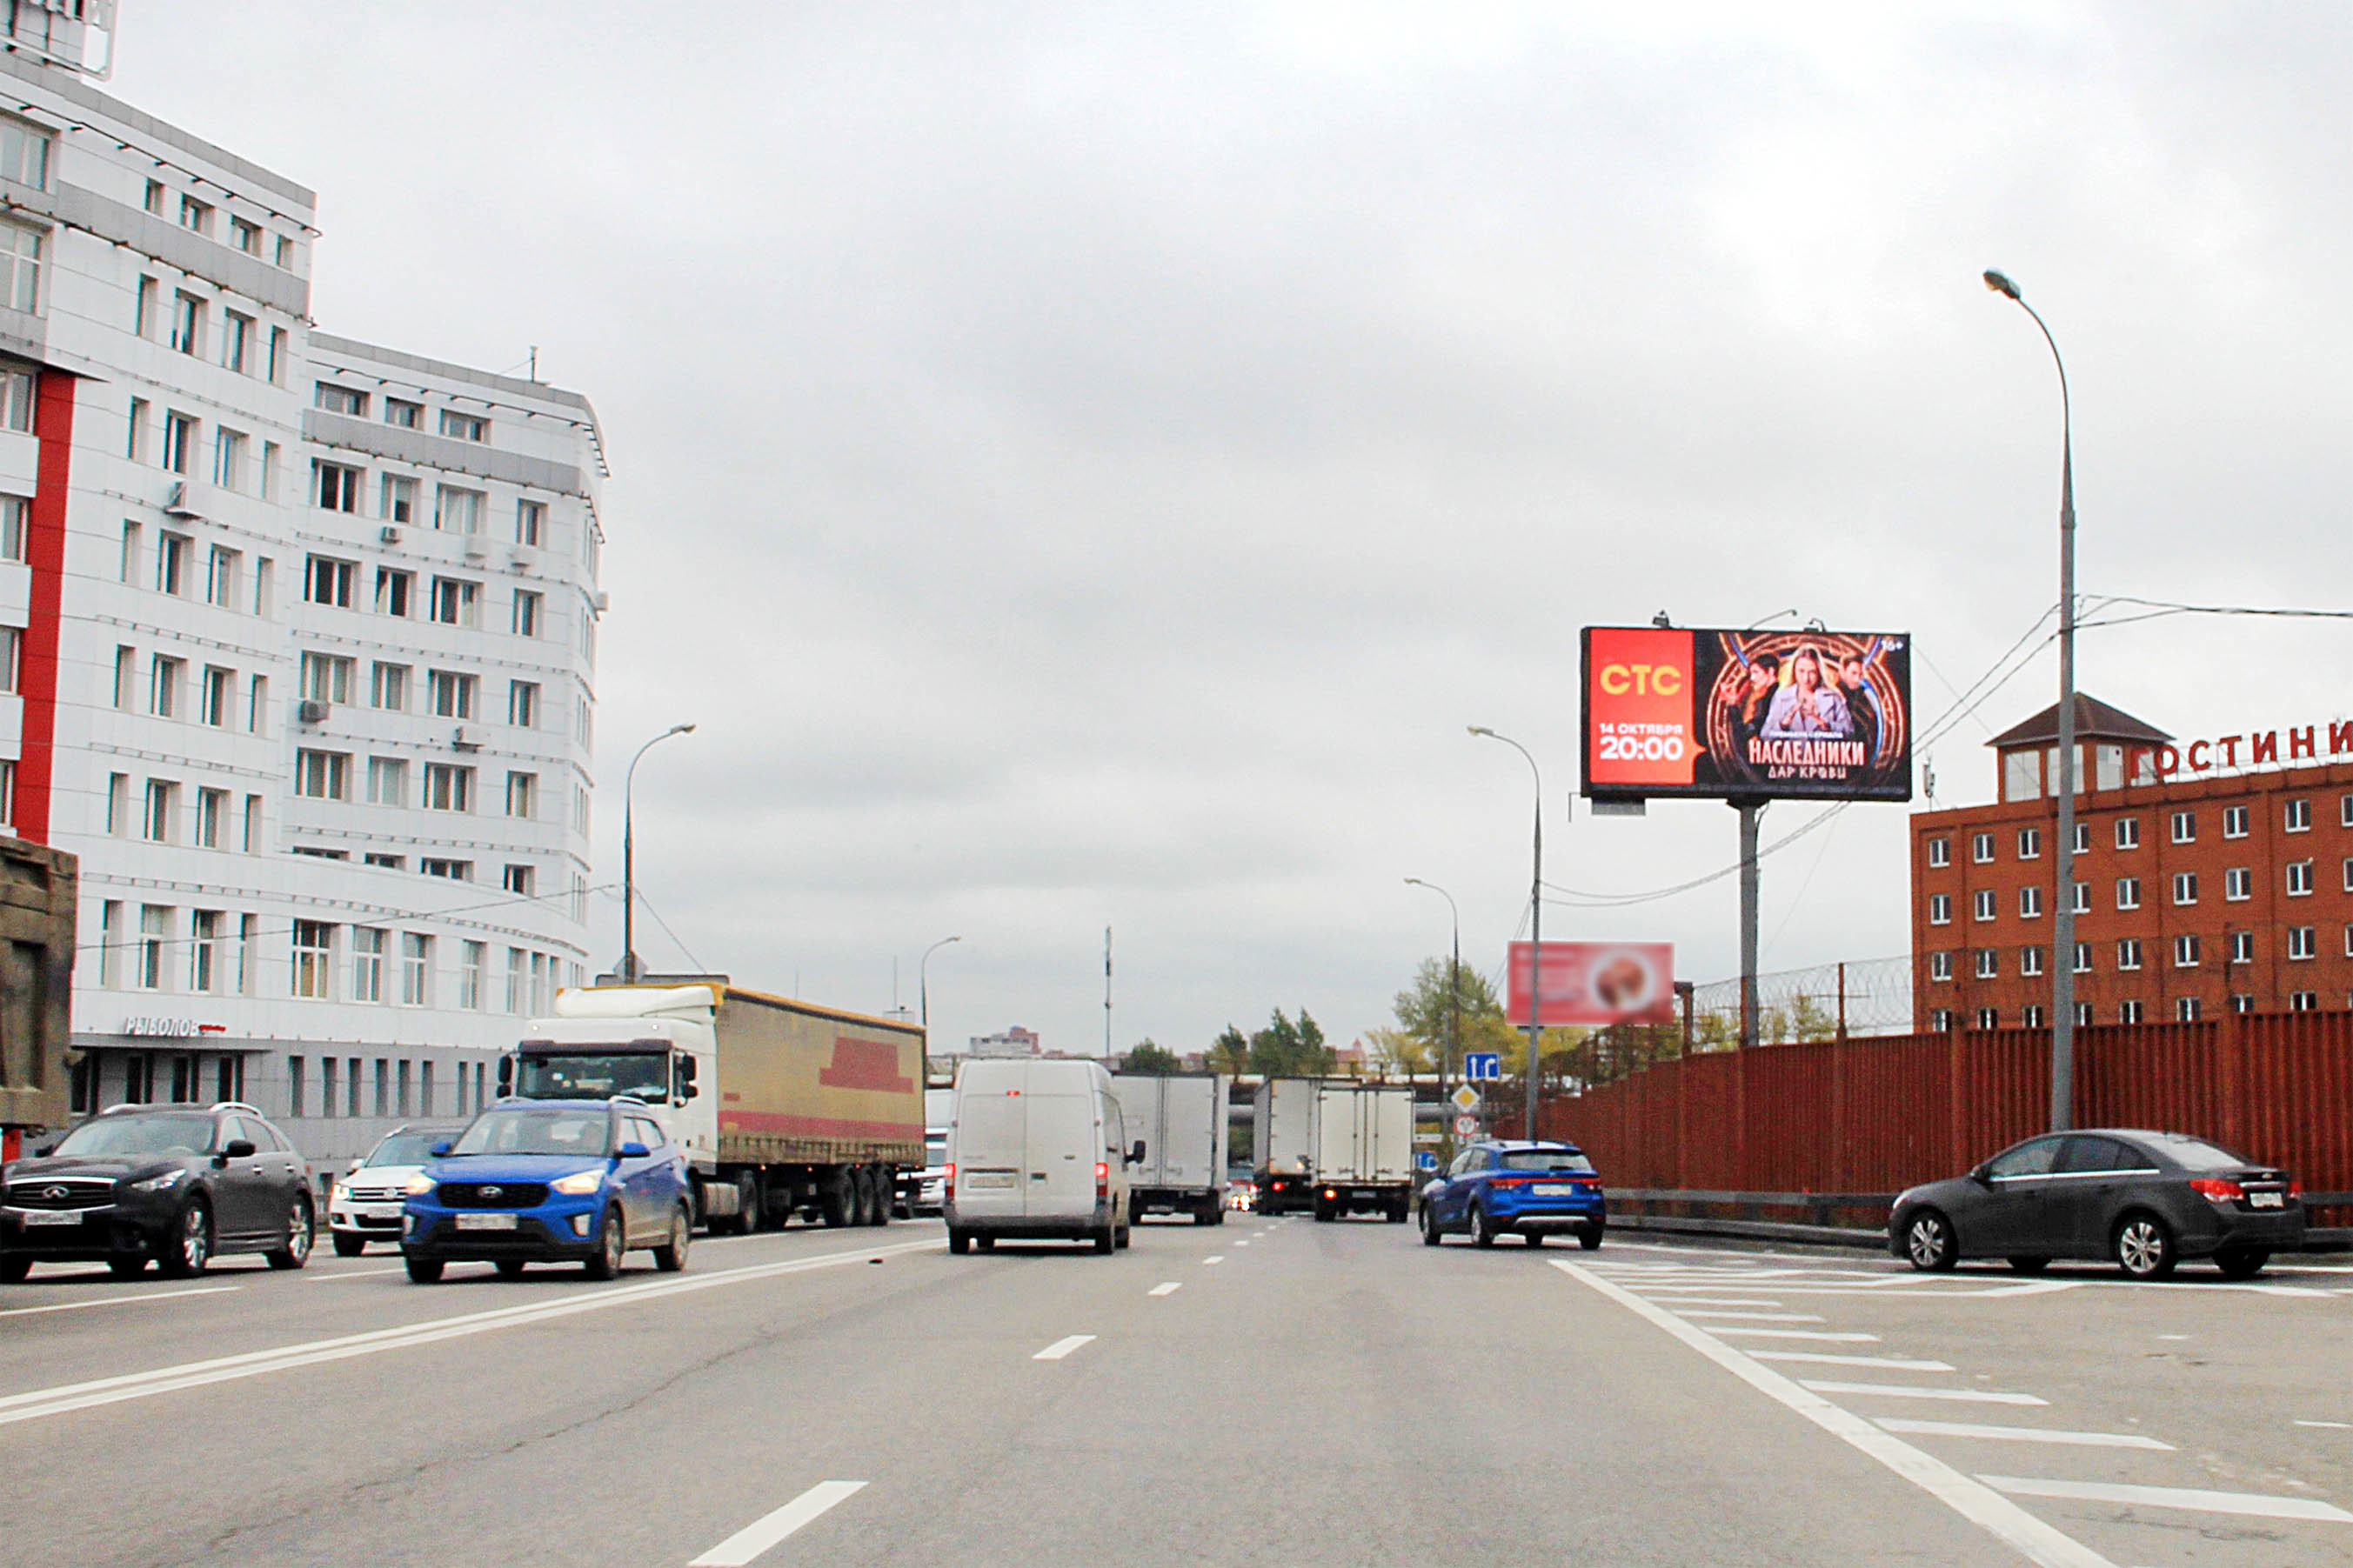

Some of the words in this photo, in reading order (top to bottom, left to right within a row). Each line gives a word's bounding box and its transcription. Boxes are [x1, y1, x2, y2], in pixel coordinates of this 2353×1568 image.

[1600, 664, 1681, 696] СТС
[1599, 723, 1614, 734] 14
[1617, 723, 1683, 735] ОКТЯБРЯ
[1600, 736, 1683, 761] 20:00
[1748, 738, 1865, 765] НАСЛЕДНИКИ
[1768, 764, 1795, 779] ДАР
